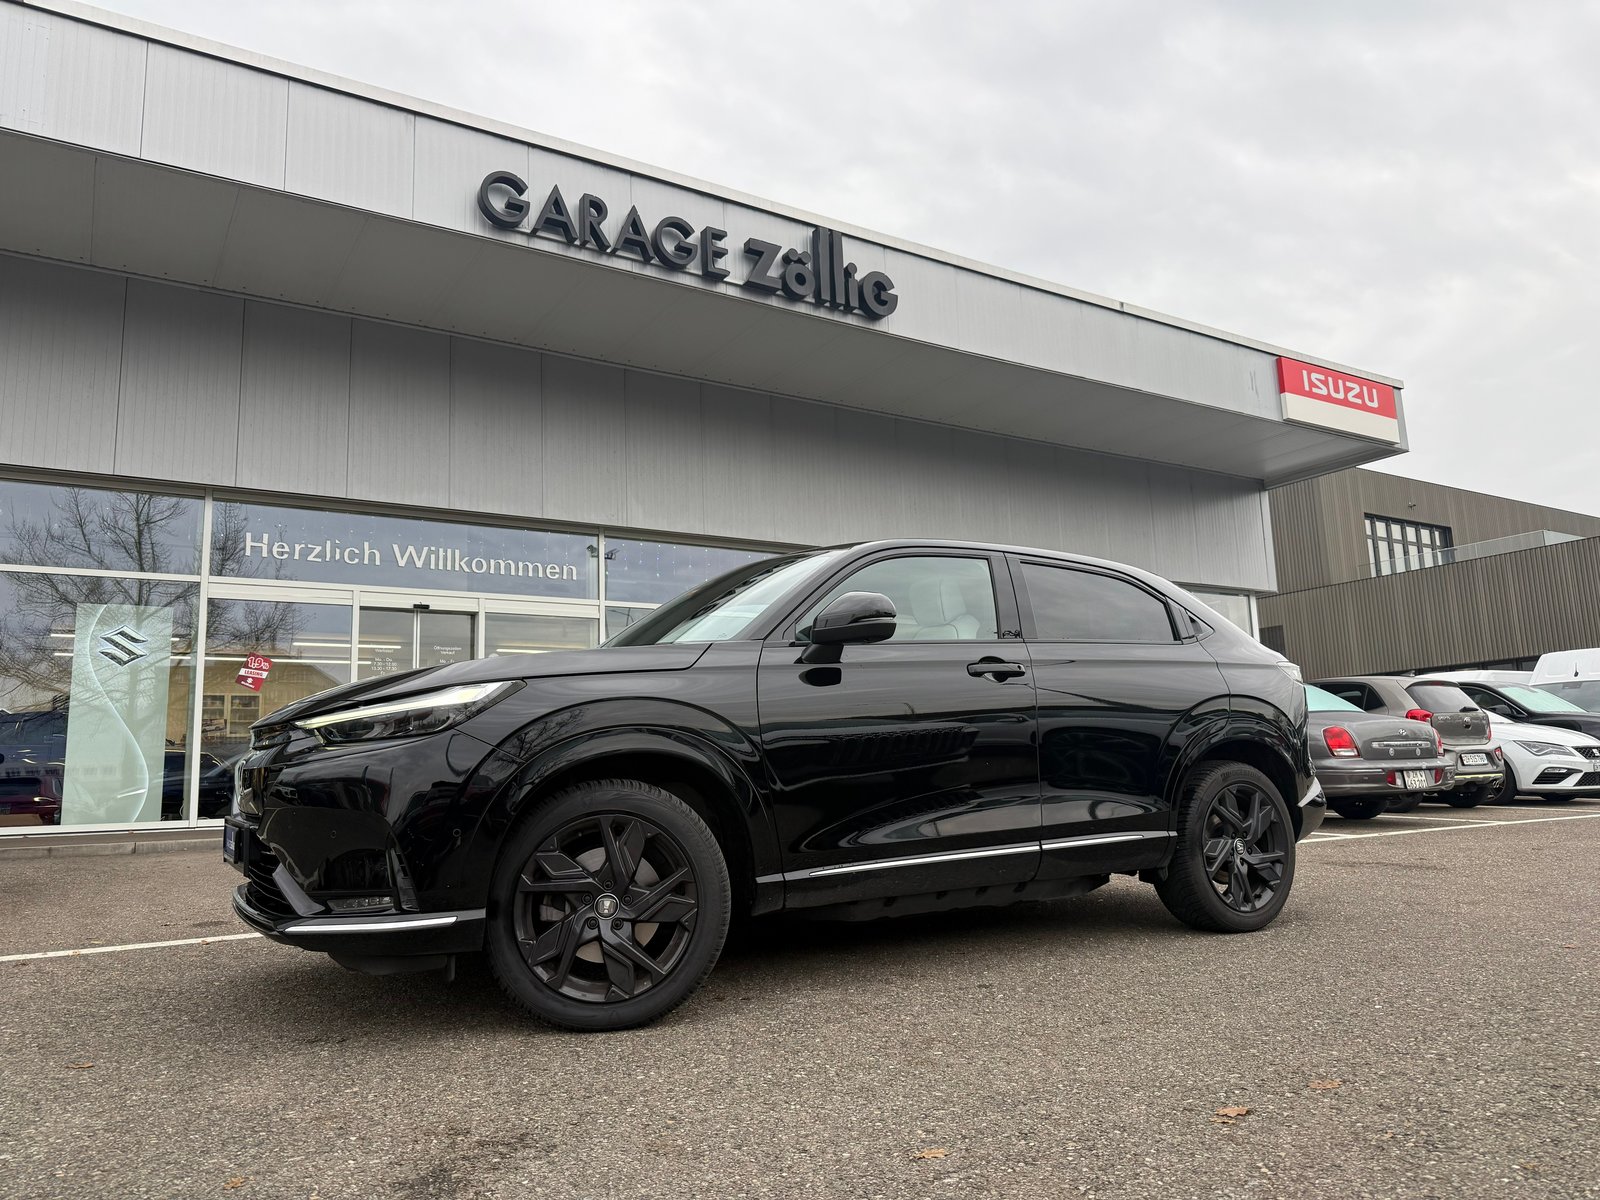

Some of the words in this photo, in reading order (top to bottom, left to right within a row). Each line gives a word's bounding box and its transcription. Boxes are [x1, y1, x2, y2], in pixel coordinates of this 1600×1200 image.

[477, 170, 730, 281] GARAGE
[1302, 369, 1379, 408] ISUZU
[244, 532, 381, 566] Herzlich
[392, 543, 577, 581] Willkommen
